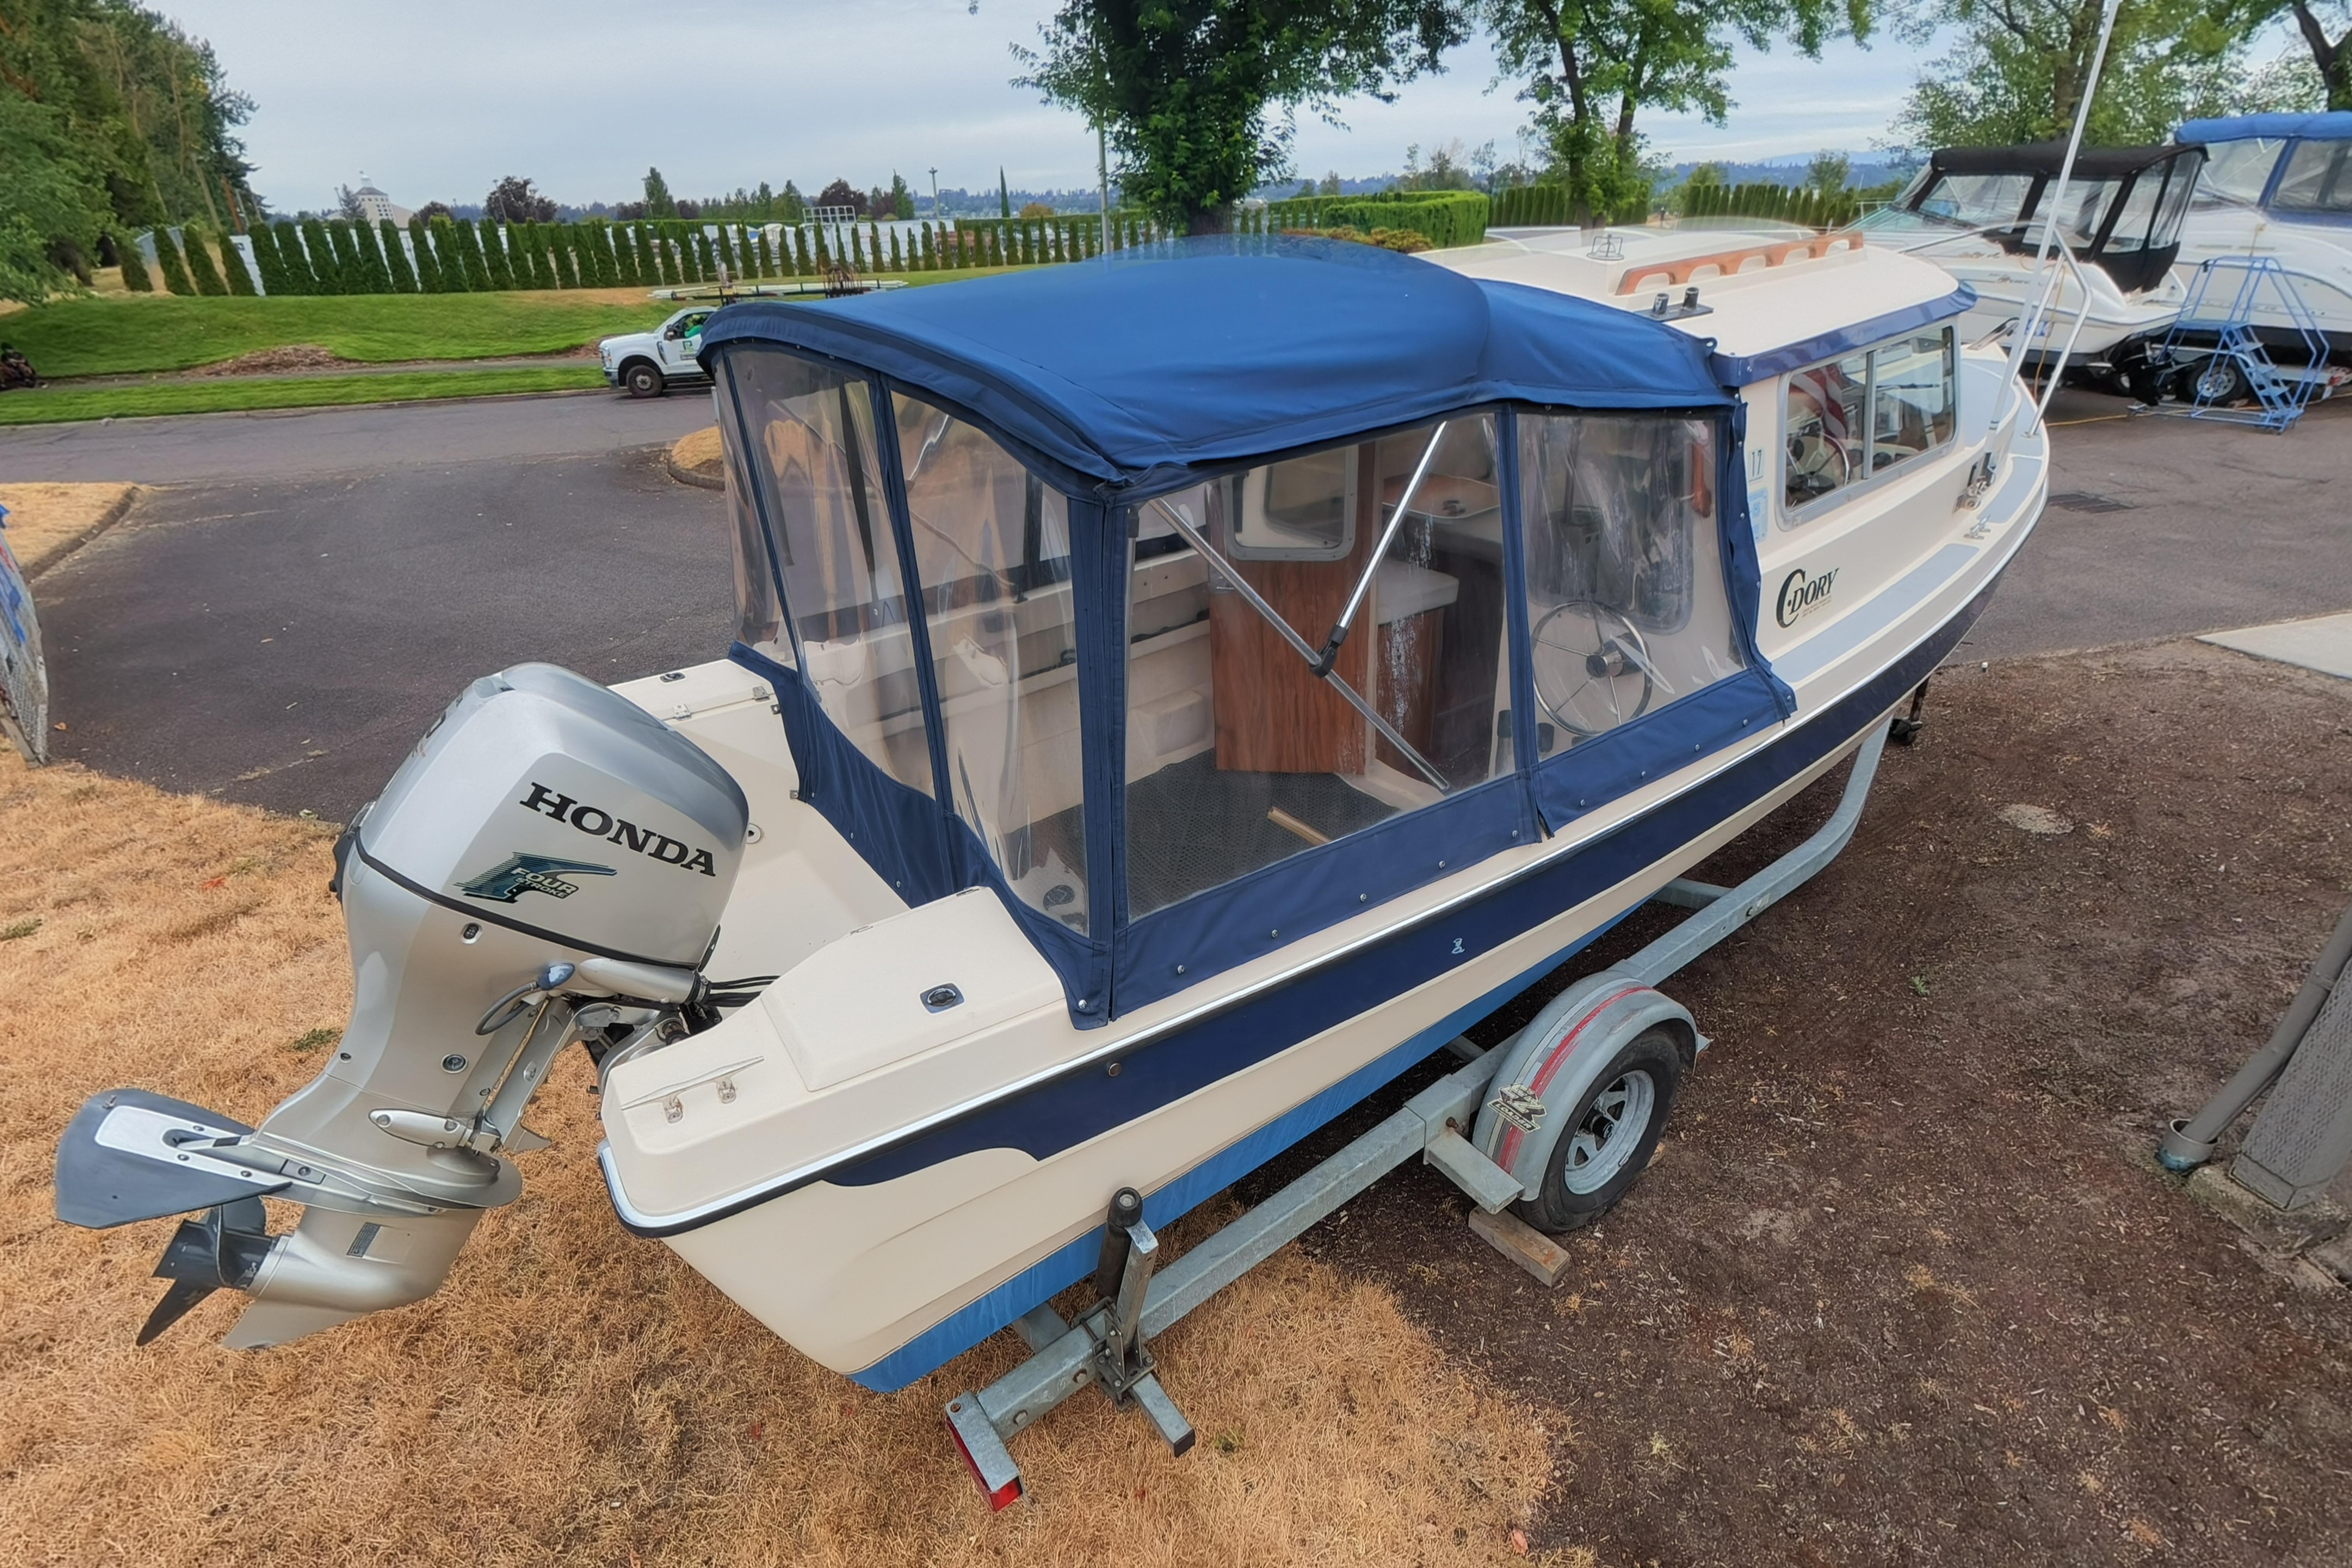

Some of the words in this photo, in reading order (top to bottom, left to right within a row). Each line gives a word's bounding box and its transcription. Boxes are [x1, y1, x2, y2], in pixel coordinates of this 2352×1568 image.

[519, 782, 716, 877] HONDA
[511, 867, 578, 894] FOUR
[515, 878, 569, 898] STROKE
[1495, 1103, 1532, 1129] LOADER
